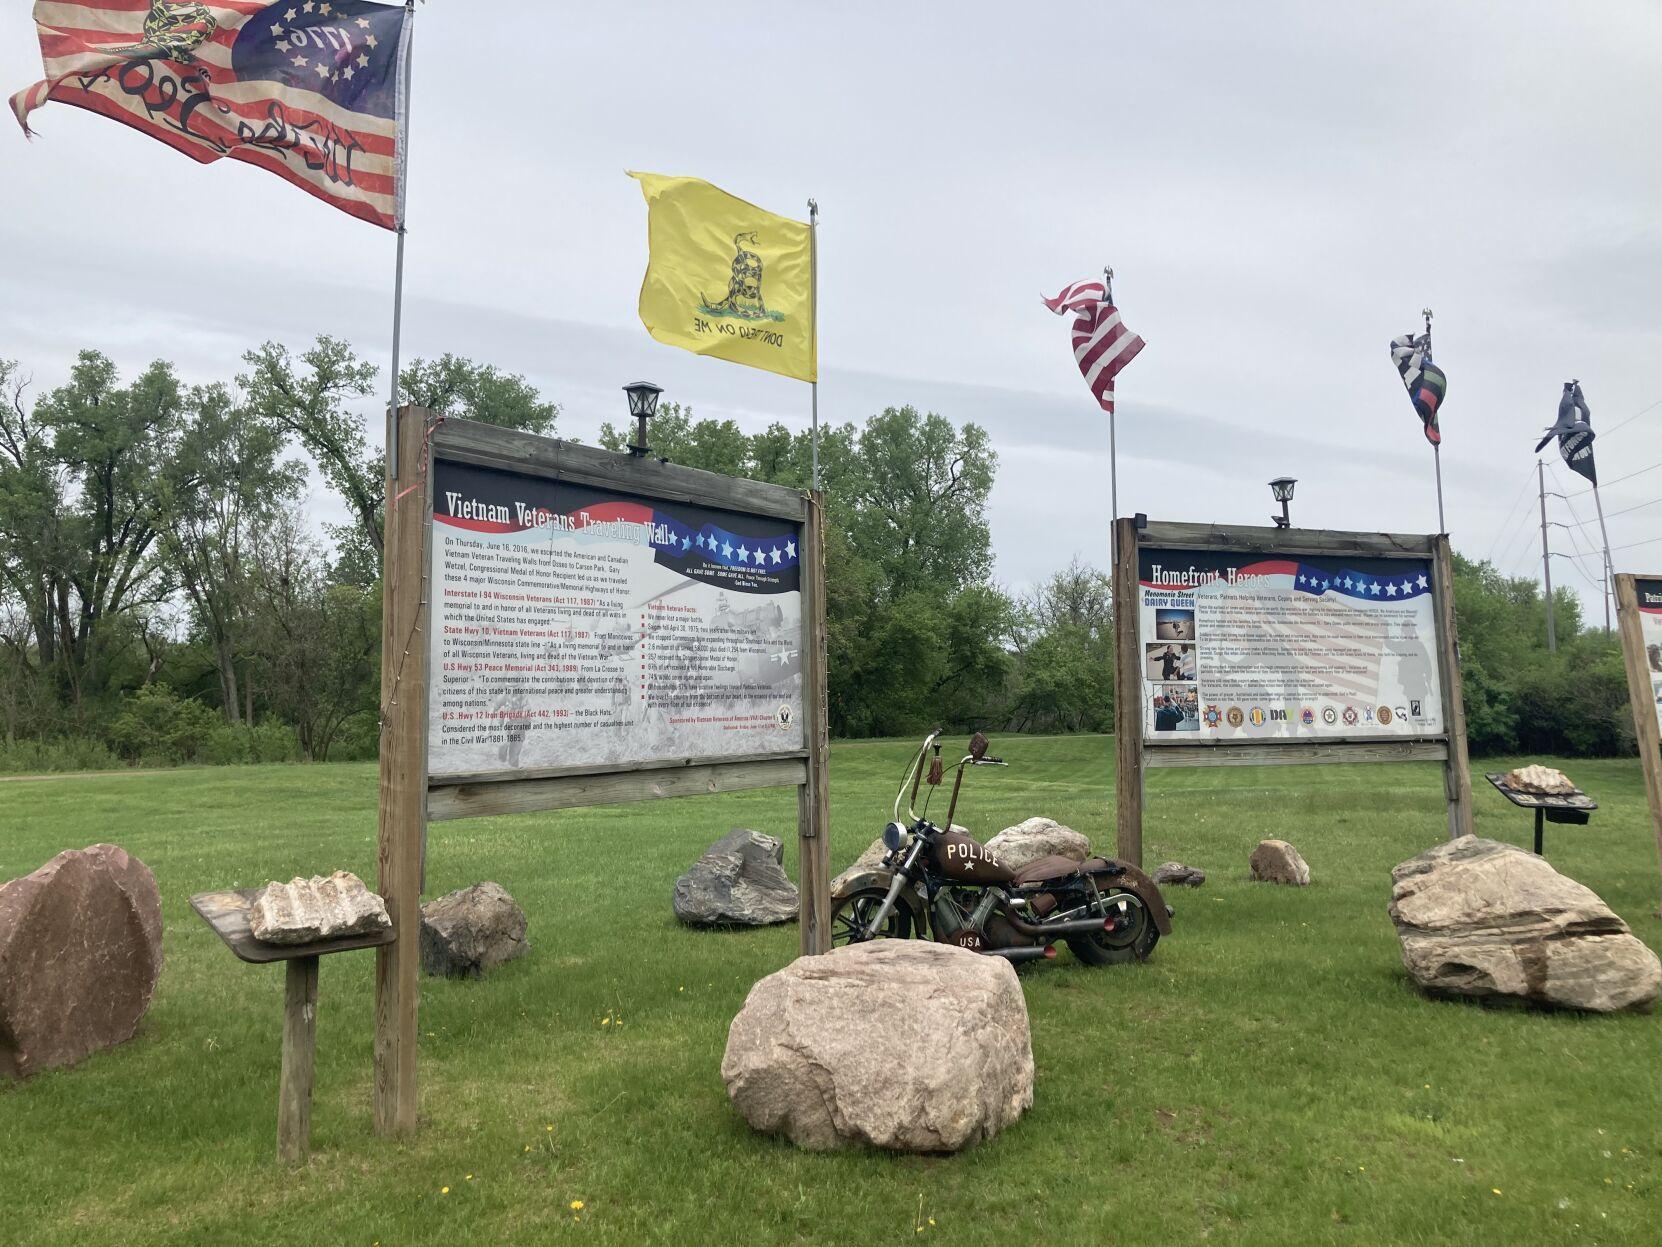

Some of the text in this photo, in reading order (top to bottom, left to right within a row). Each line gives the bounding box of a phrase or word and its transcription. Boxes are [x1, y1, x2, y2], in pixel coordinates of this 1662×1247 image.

[445, 491, 670, 546] Vietnam Veterans Traveling Wall
[445, 536, 454, 546] On
[456, 538, 485, 550] Thursday,
[486, 541, 500, 550] June
[564, 550, 572, 558] the
[574, 552, 596, 560] American
[598, 554, 606, 562] and
[607, 555, 628, 564] Canadian
[445, 549, 470, 560] Vietnam
[472, 552, 494, 561] Veteran
[496, 554, 521, 565] Traveling
[522, 557, 537, 566] Walls
[576, 562, 593, 570] Carson
[608, 566, 620, 574] Gary
[445, 561, 468, 571] Wetzel,
[470, 563, 509, 574] Congressional
[510, 566, 528, 576] Medal
[552, 570, 576, 580] Recipient
[1151, 564, 1271, 588] Homefront Heroes
[444, 574, 516, 586] these 4 major Wisconsin
[444, 588, 624, 610] Interstate Wisconsin Veterans living
[1144, 590, 1194, 598] Menomonie Street
[444, 602, 472, 610] memorial
[500, 604, 516, 612] honor
[534, 606, 556, 614] Veterans
[558, 608, 572, 616] living
[572, 608, 582, 616] and
[1144, 598, 1194, 608] DAIRY QUEEN
[444, 612, 462, 620] which
[464, 614, 474, 622] the
[476, 614, 495, 622] United
[496, 615, 515, 624] States
[444, 626, 546, 637] State Hwy Vietnam Veterans
[444, 638, 450, 646] to
[563, 642, 576, 651] living
[444, 650, 450, 658] of
[452, 650, 460, 658] all
[462, 650, 490, 658] Wisconsin
[492, 652, 518, 660] Veterans,
[520, 652, 534, 660] living
[458, 663, 472, 672] Hwy
[484, 664, 502, 672] Peace
[504, 664, 533, 672] Memorial
[443, 674, 468, 684] Superior
[442, 687, 466, 695] citizens
[468, 686, 474, 694] of
[548, 688, 563, 696] peace
[574, 688, 593, 696] greater
[594, 687, 628, 695] understanding
[442, 700, 463, 708] among
[500, 710, 522, 720] Brigade
[584, 708, 598, 716] Black
[442, 724, 476, 733] Considered
[477, 724, 486, 732] the
[532, 722, 542, 730] and
[544, 722, 552, 730] the
[554, 722, 572, 730] highest
[594, 720, 598, 728] of
[600, 720, 624, 728] casualties
[461, 736, 474, 744] Civil
[476, 736, 488, 744] War
[947, 843, 999, 867] POLICE
[960, 936, 981, 947] USA
